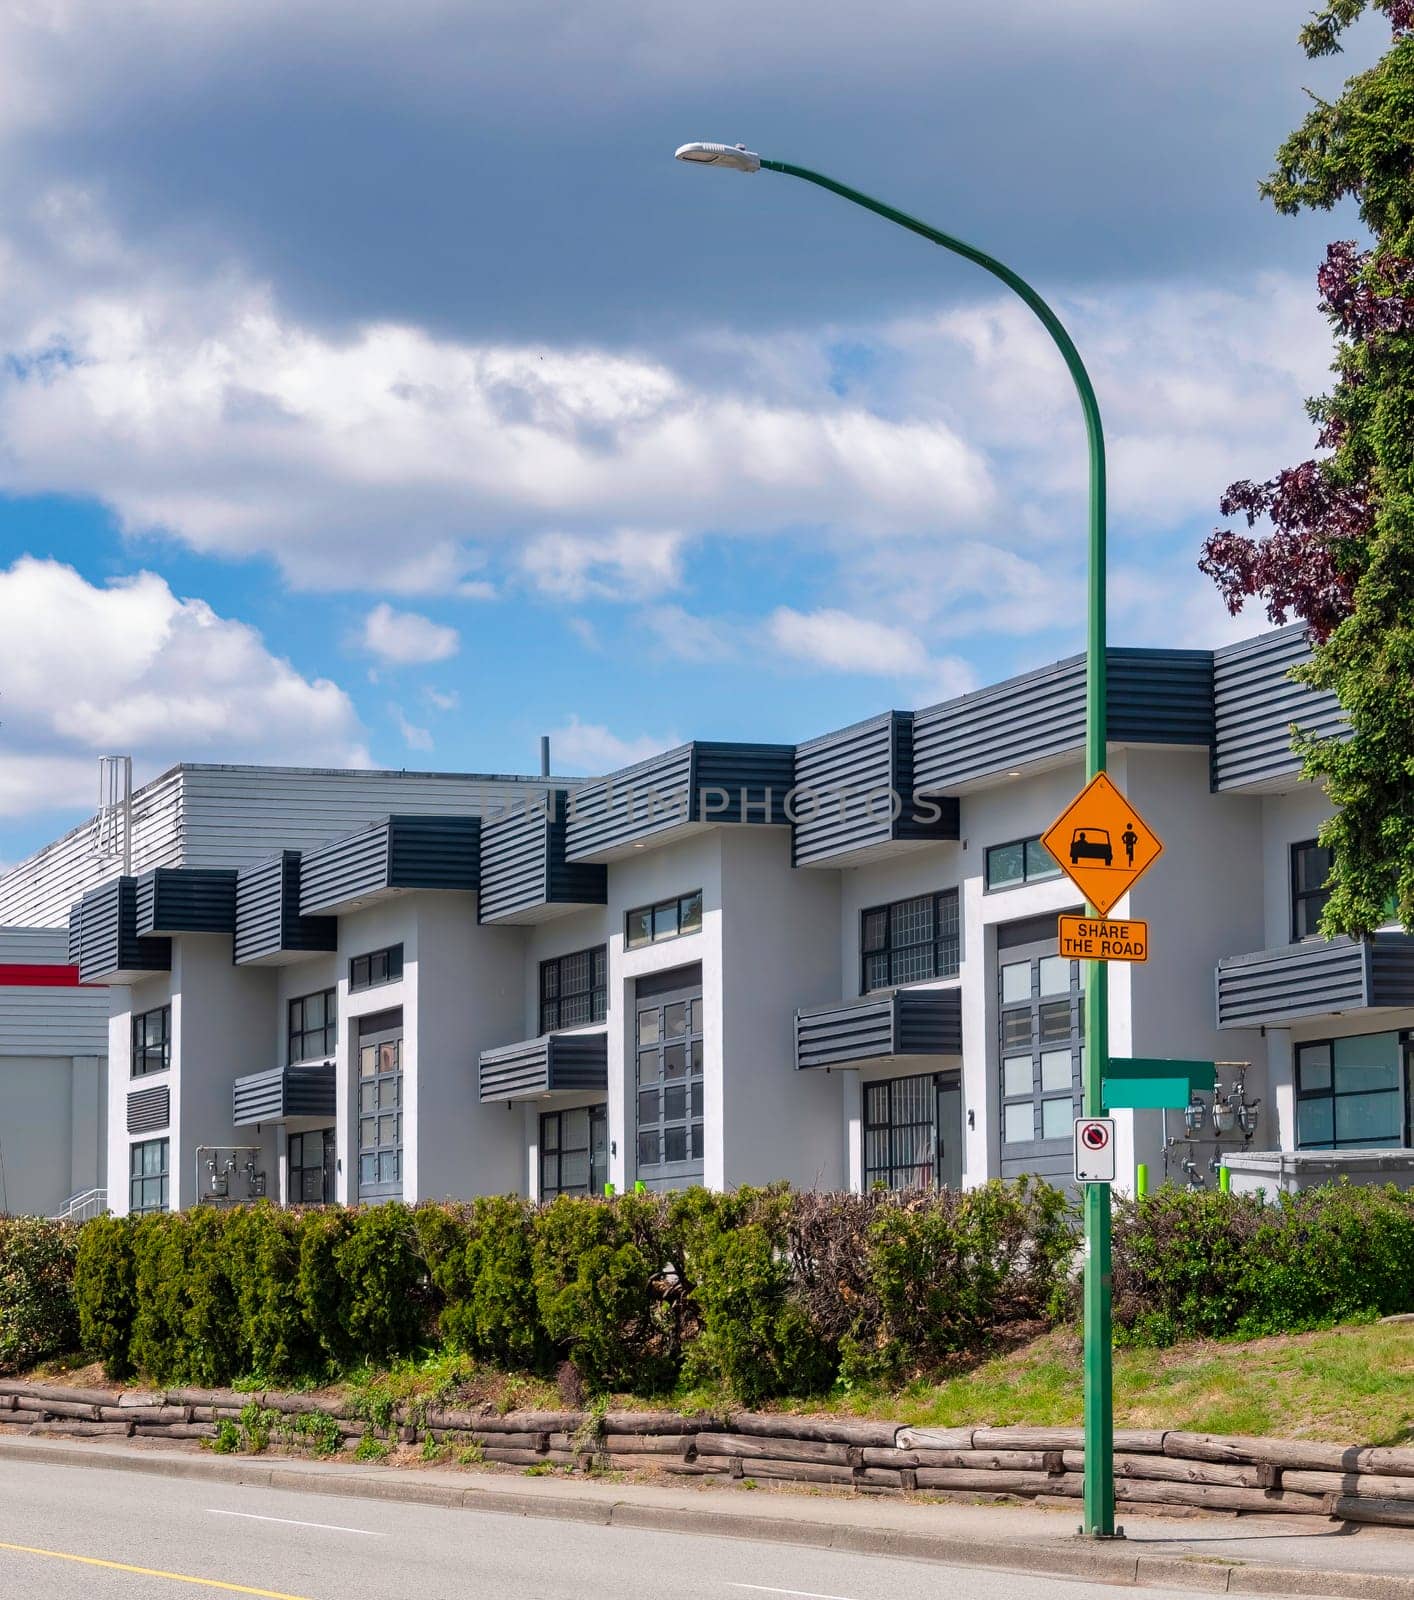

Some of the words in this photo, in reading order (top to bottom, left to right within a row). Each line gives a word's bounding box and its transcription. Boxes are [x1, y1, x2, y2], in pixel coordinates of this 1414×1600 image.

[1078, 923, 1129, 939] SHARE
[1064, 938, 1093, 953] THE
[1102, 940, 1144, 956] ROAD
